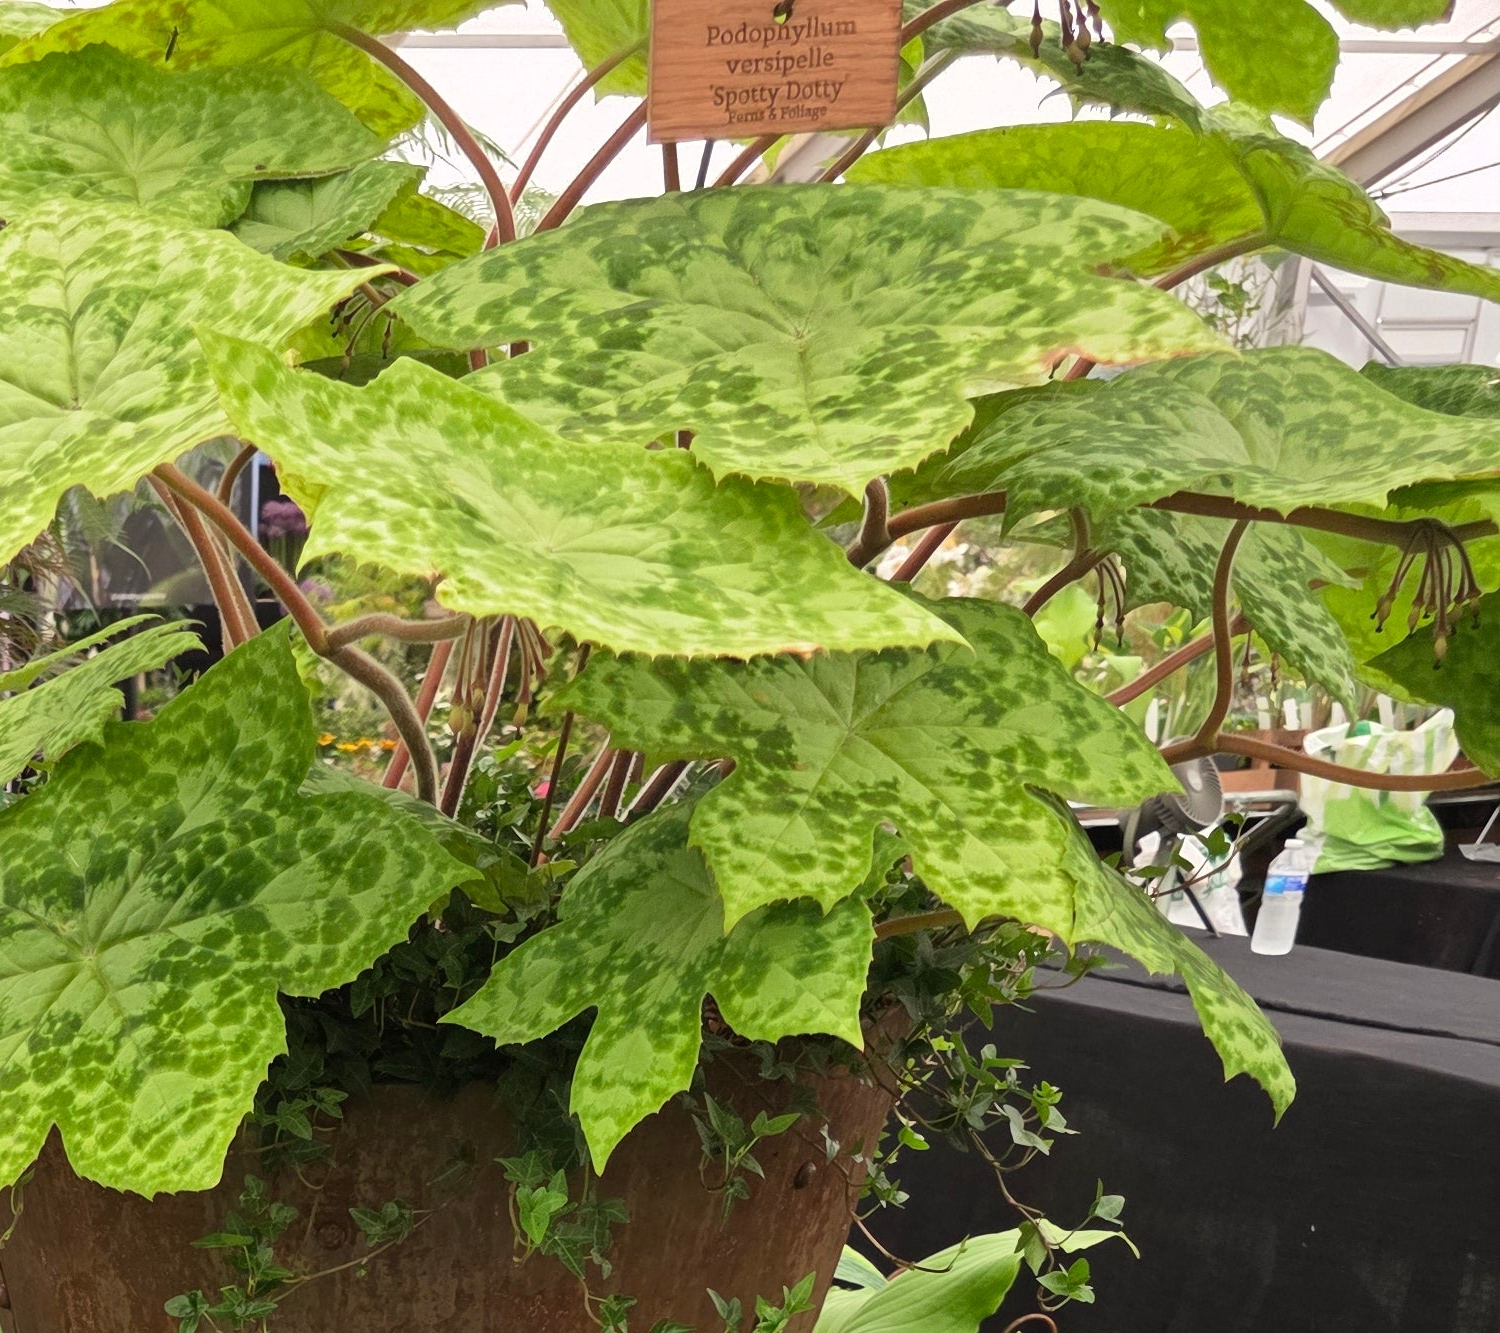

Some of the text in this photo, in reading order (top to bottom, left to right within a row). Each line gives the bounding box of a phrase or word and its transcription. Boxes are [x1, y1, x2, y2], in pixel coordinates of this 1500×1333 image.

[706, 15, 857, 48] Podophyllum
[726, 46, 835, 77] versipelle
[709, 73, 850, 113] 'Spotty Dotty'
[728, 104, 828, 124] Ferns & Foliage
